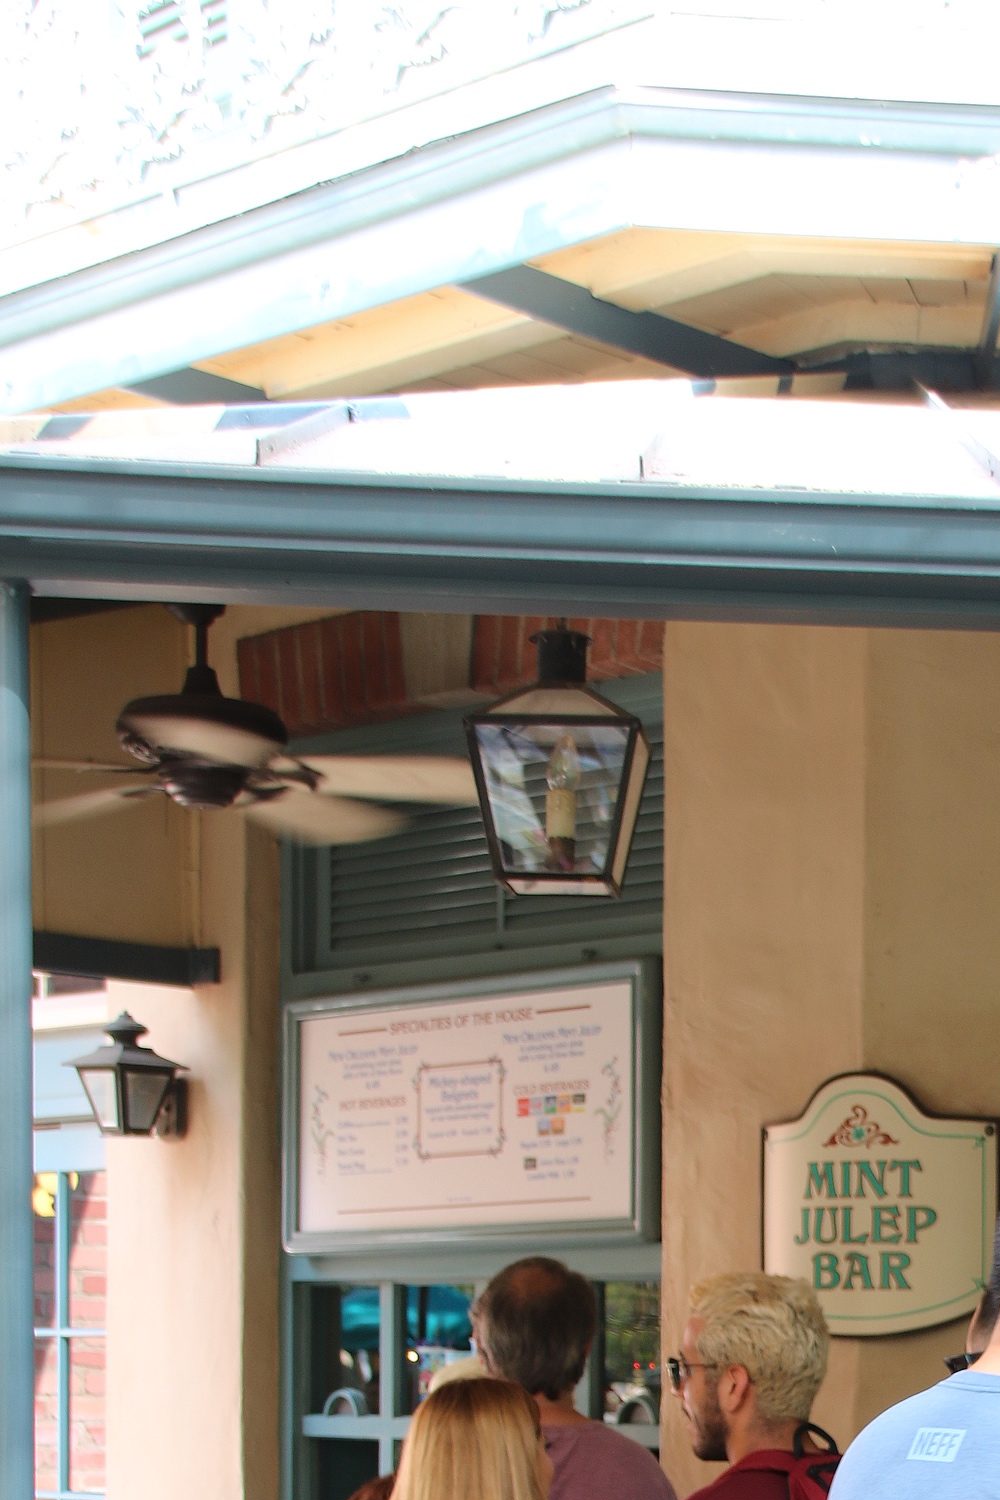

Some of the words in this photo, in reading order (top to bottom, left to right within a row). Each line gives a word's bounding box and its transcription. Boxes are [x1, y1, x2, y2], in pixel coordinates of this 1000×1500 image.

[803, 1159, 923, 1199] MINT
[793, 1204, 937, 1245] JULEP
[811, 1251, 913, 1291] BAR
